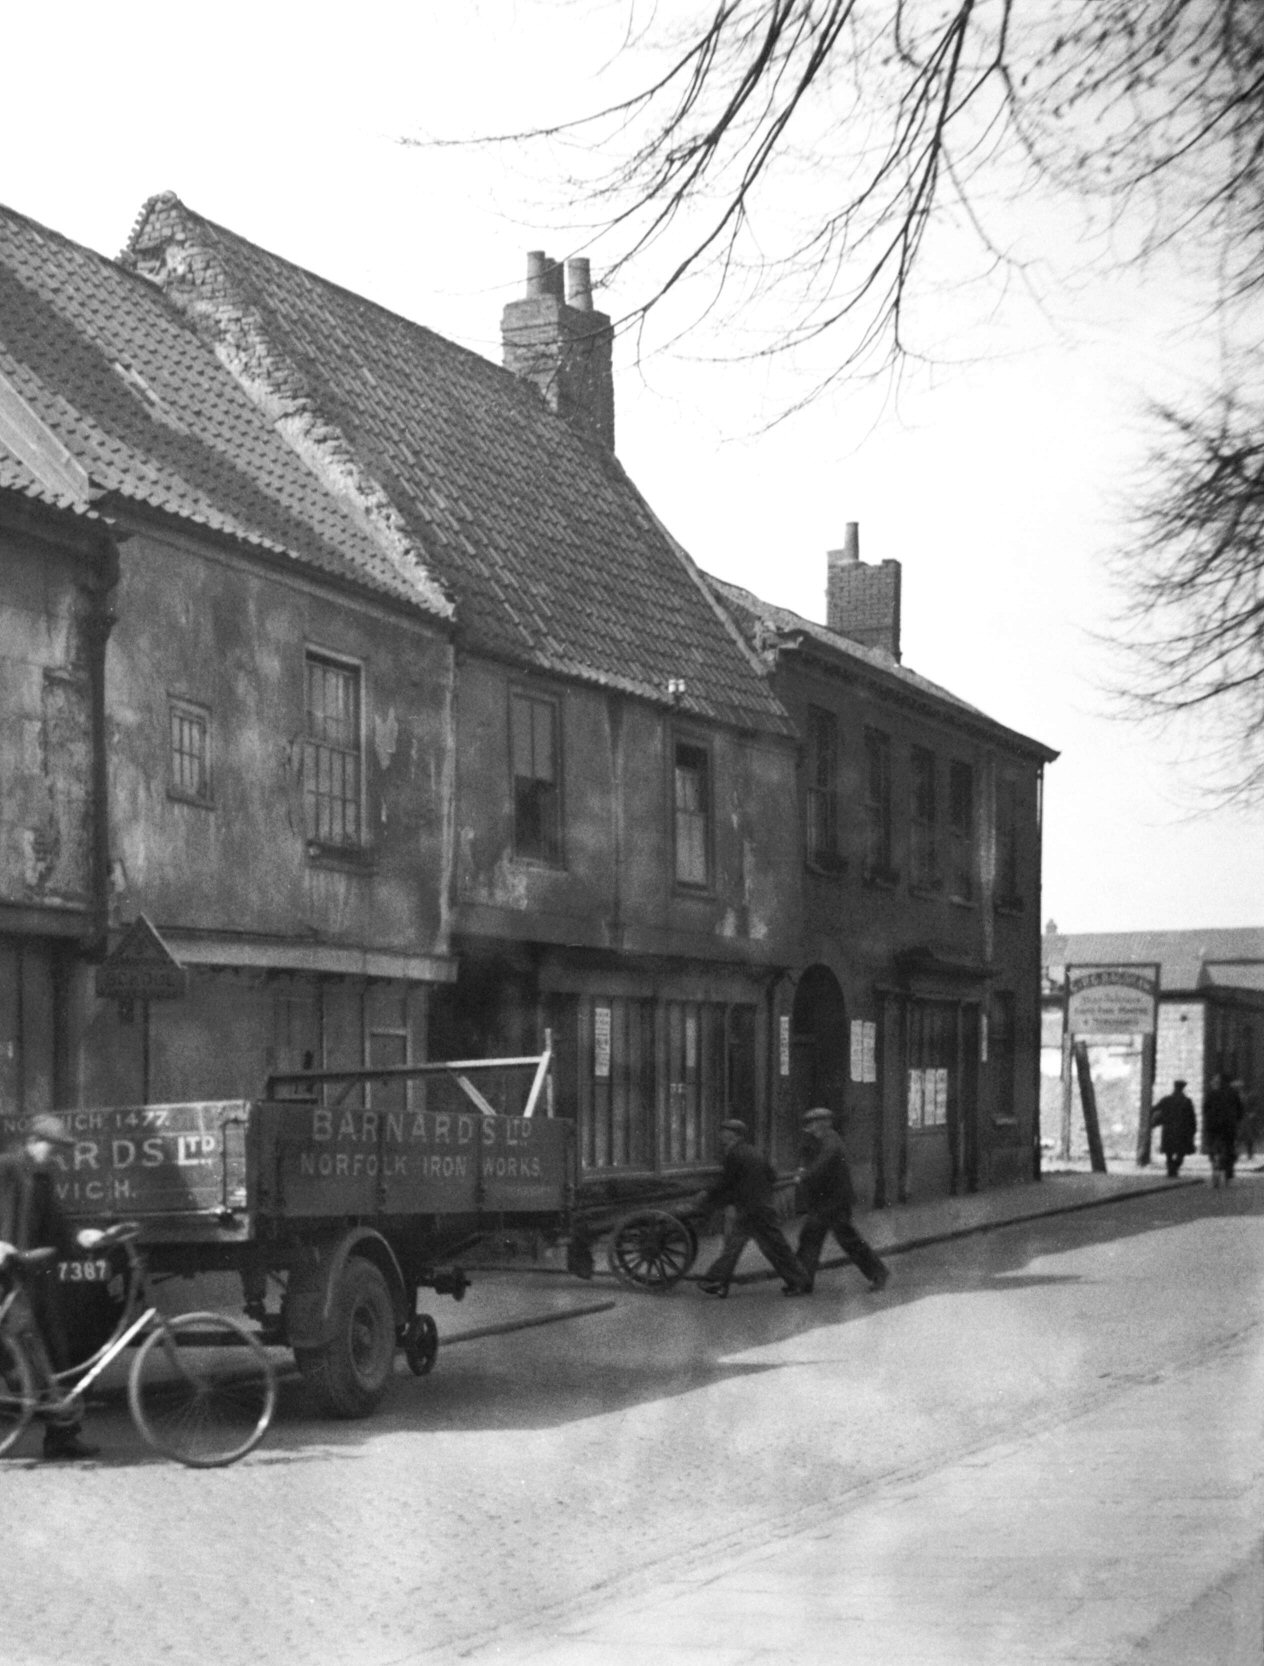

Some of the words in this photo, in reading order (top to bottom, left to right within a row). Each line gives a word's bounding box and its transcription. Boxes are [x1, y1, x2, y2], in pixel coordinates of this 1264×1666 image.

[313, 1108, 495, 1146] BARNARDS
[300, 1153, 408, 1177] NORFOLK
[422, 1154, 468, 1178] IRON
[58, 1257, 107, 1281] 7387
